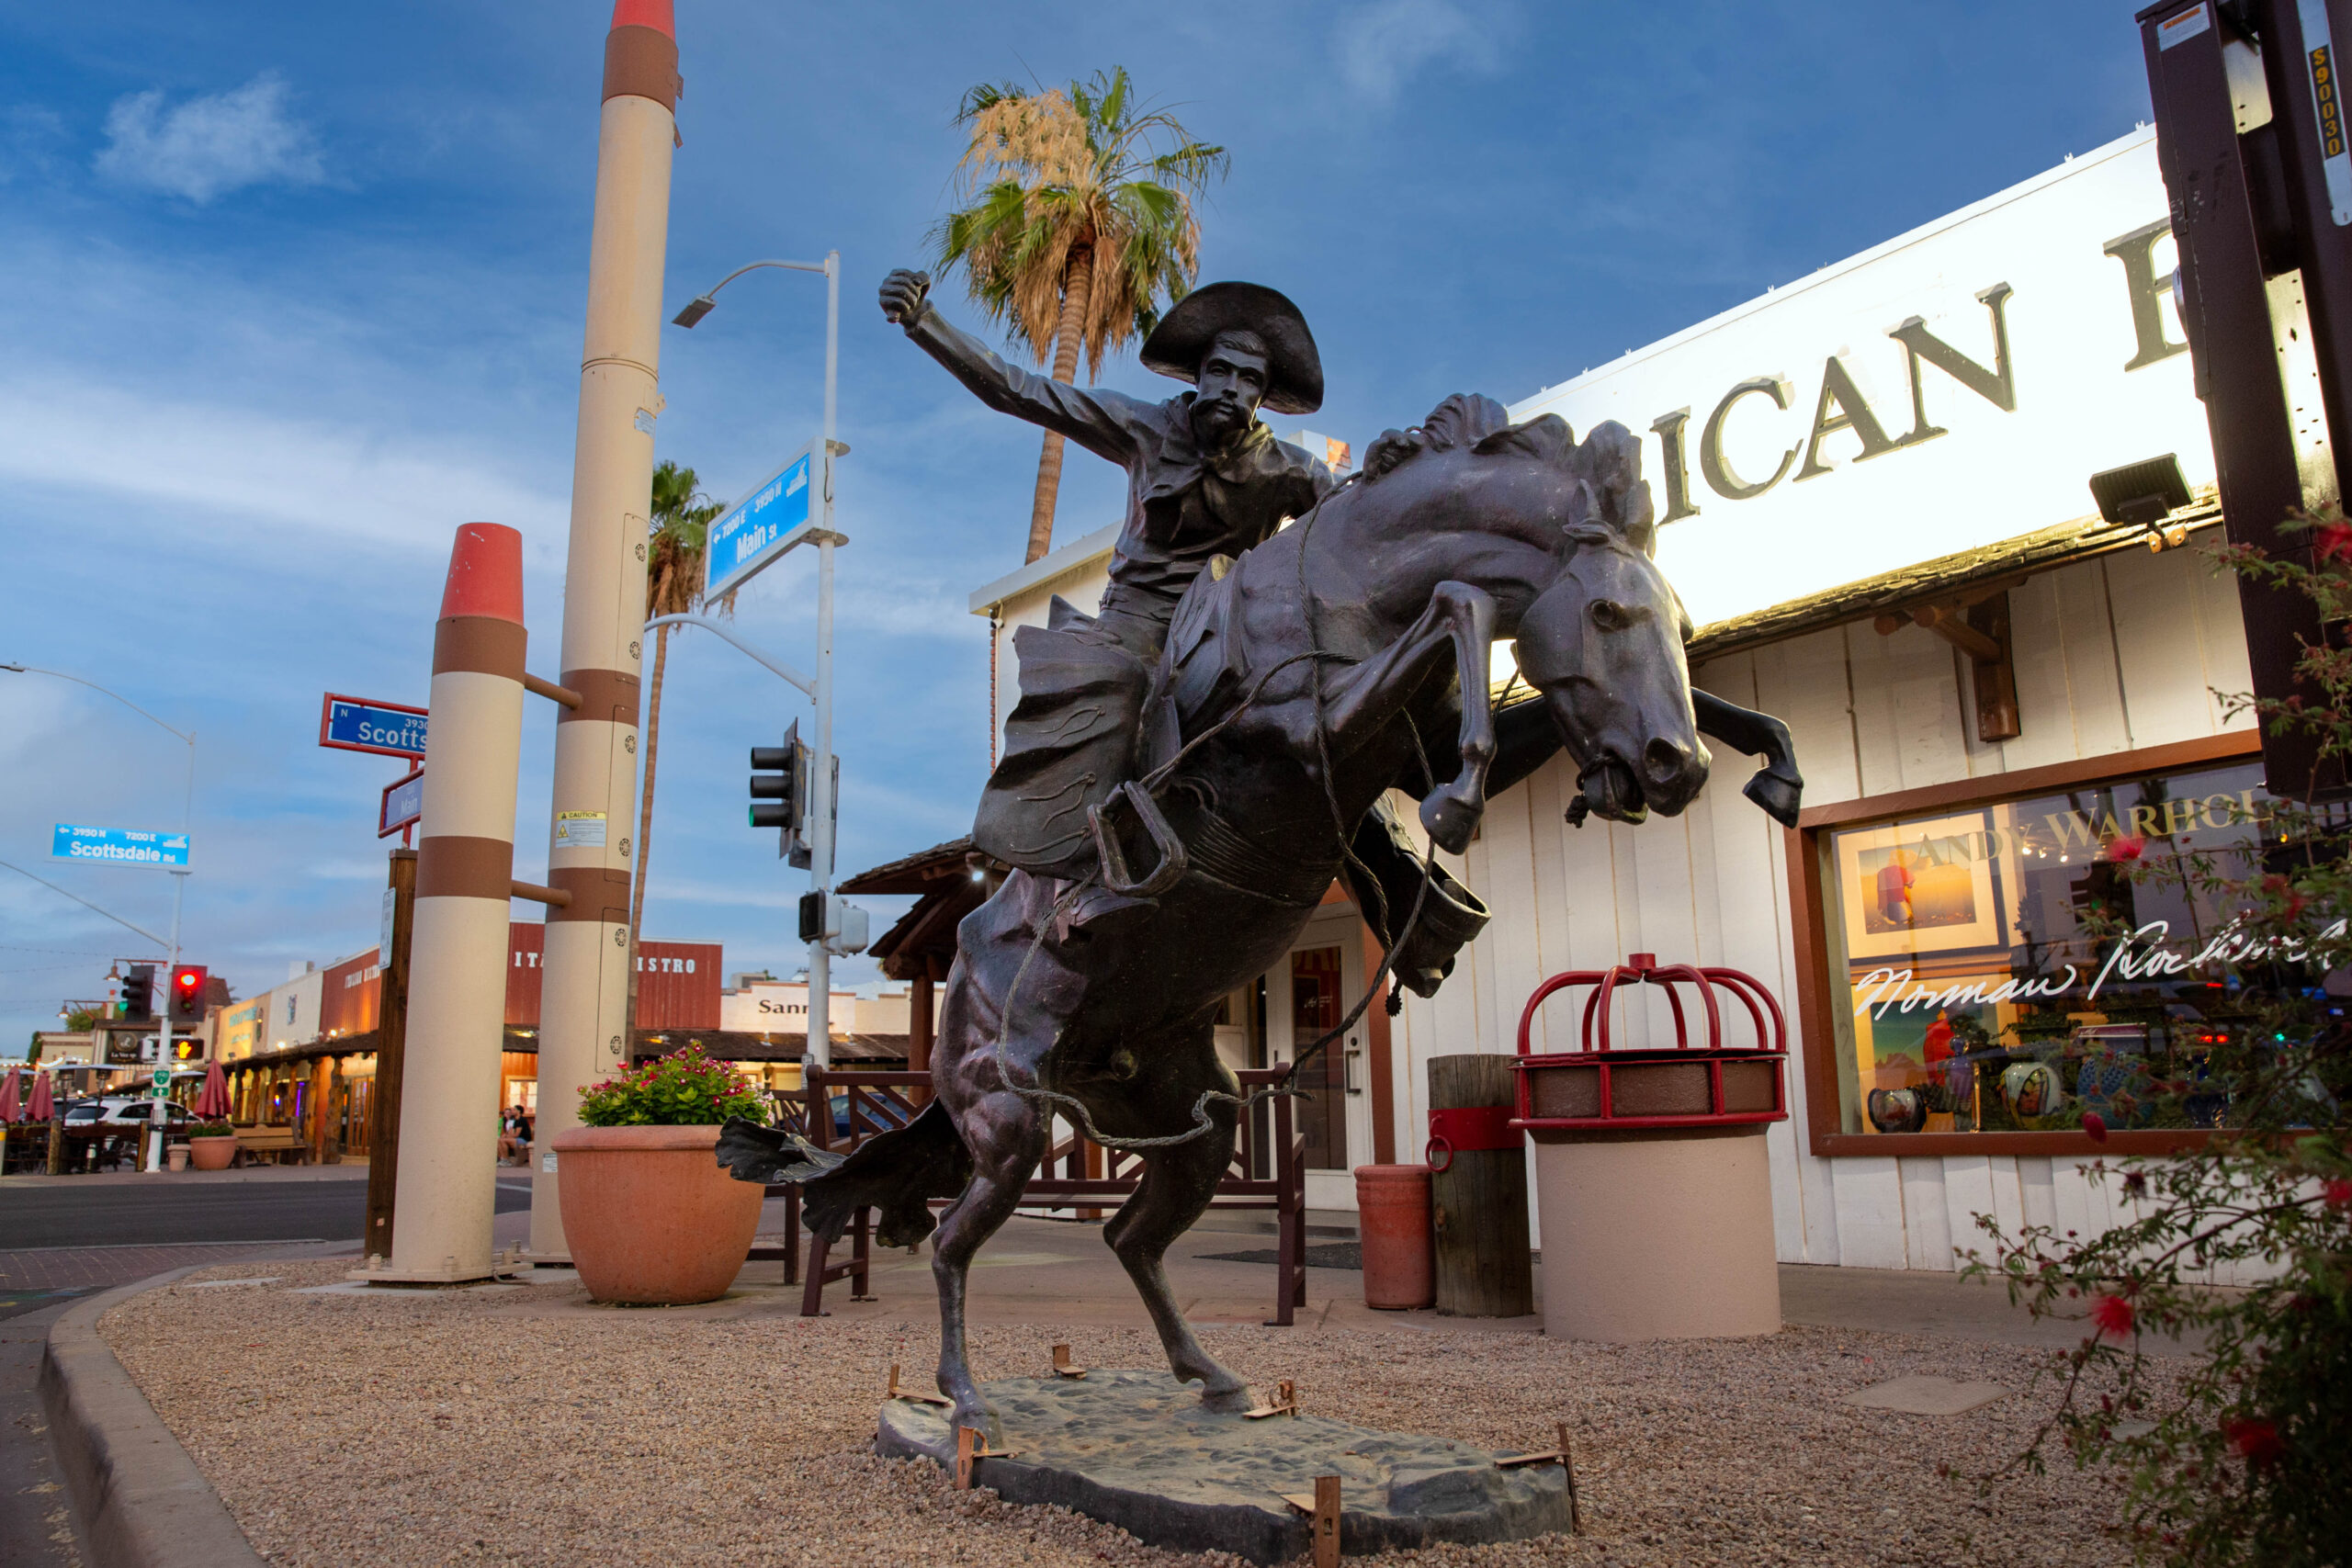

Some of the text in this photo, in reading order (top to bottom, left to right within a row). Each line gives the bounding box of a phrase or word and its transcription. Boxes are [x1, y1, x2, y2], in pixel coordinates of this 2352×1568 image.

[2312, 48, 2341, 156] S90030
[741, 510, 746, 525] E
[737, 523, 777, 562] Main St
[340, 708, 348, 717] N
[98, 829, 107, 838] N
[149, 834, 156, 842] E
[1915, 789, 2274, 867] ANDY WARHOL
[70, 840, 175, 863] Scottsdale Rd
[1854, 964, 2076, 1021] Norman
